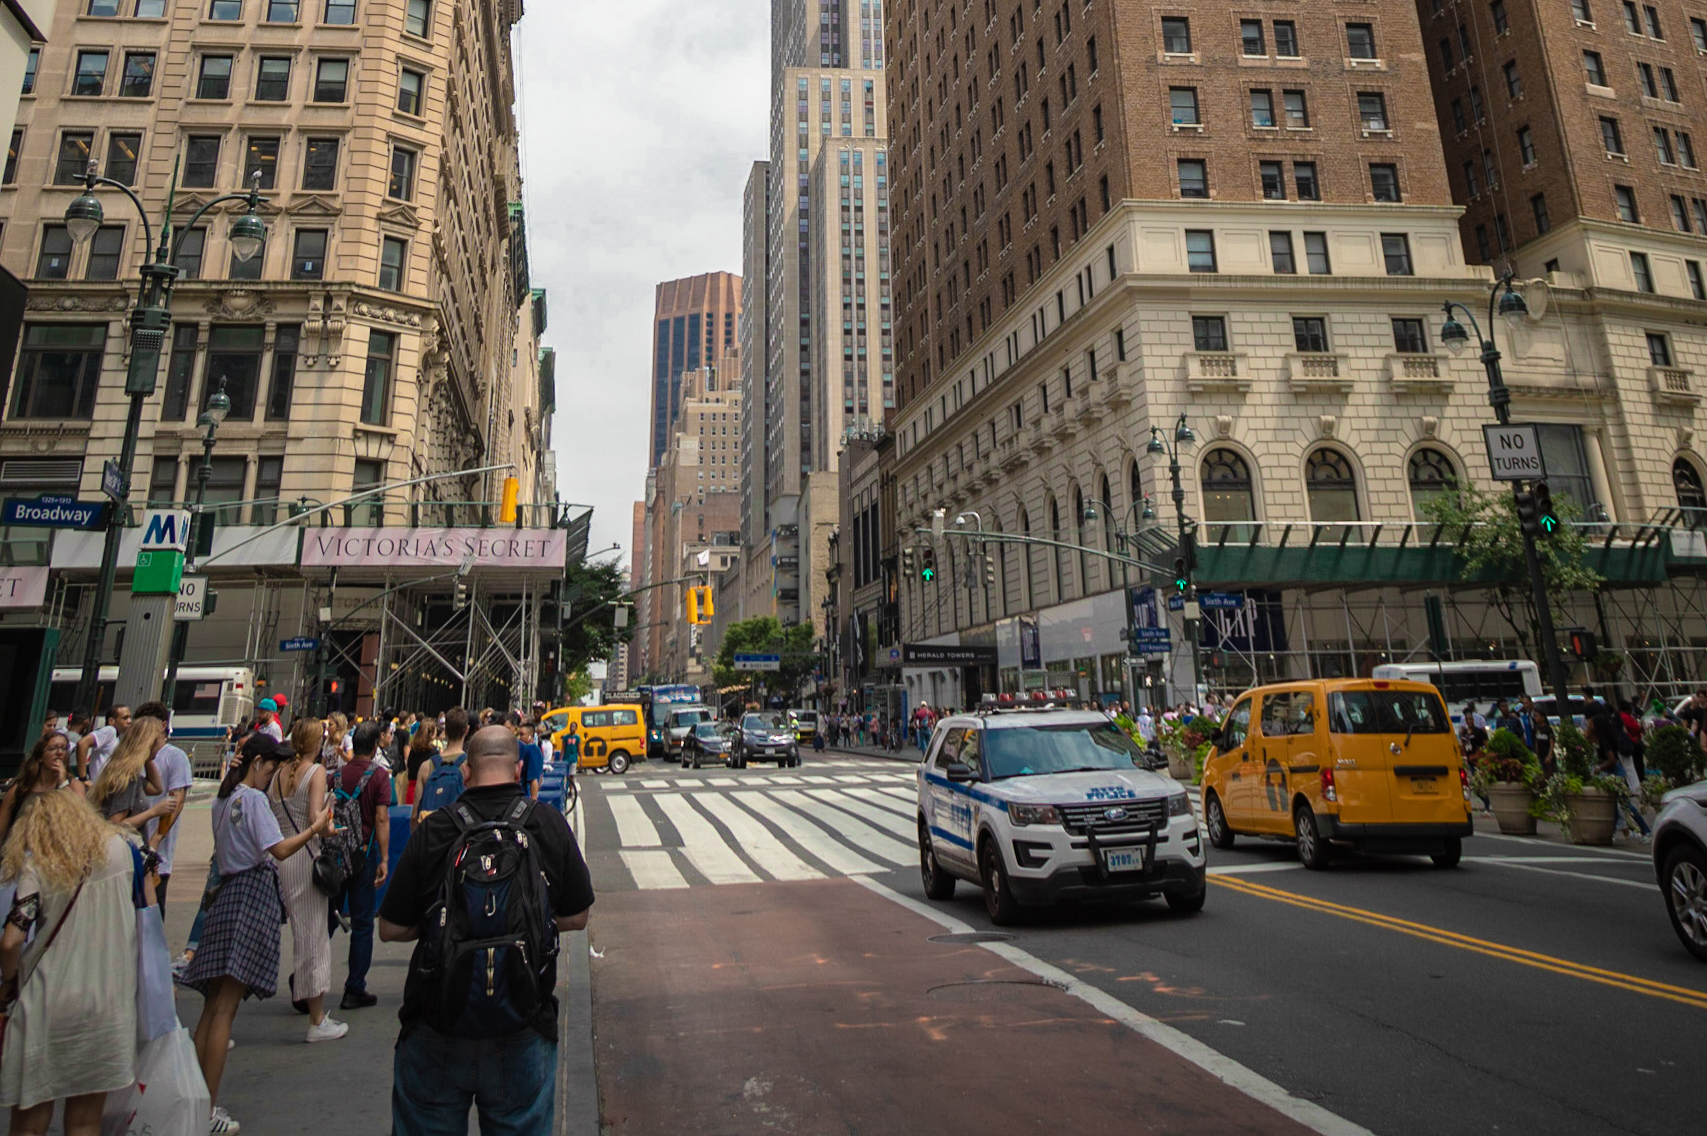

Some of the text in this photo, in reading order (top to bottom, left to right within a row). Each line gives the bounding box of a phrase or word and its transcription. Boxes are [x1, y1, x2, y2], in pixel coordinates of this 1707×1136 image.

[1499, 432, 1525, 450] NO
[1494, 456, 1539, 470] TURNS
[15, 504, 92, 526] Broadway
[142, 514, 176, 545] M
[316, 535, 552, 558] VICTORIA'S SECRET
[174, 601, 201, 613] RNS
[1204, 596, 1237, 607] Sixth Ave
[285, 640, 314, 650] Sixth Ave
[917, 651, 945, 659] HERALD
[946, 651, 976, 659] TOWERS
